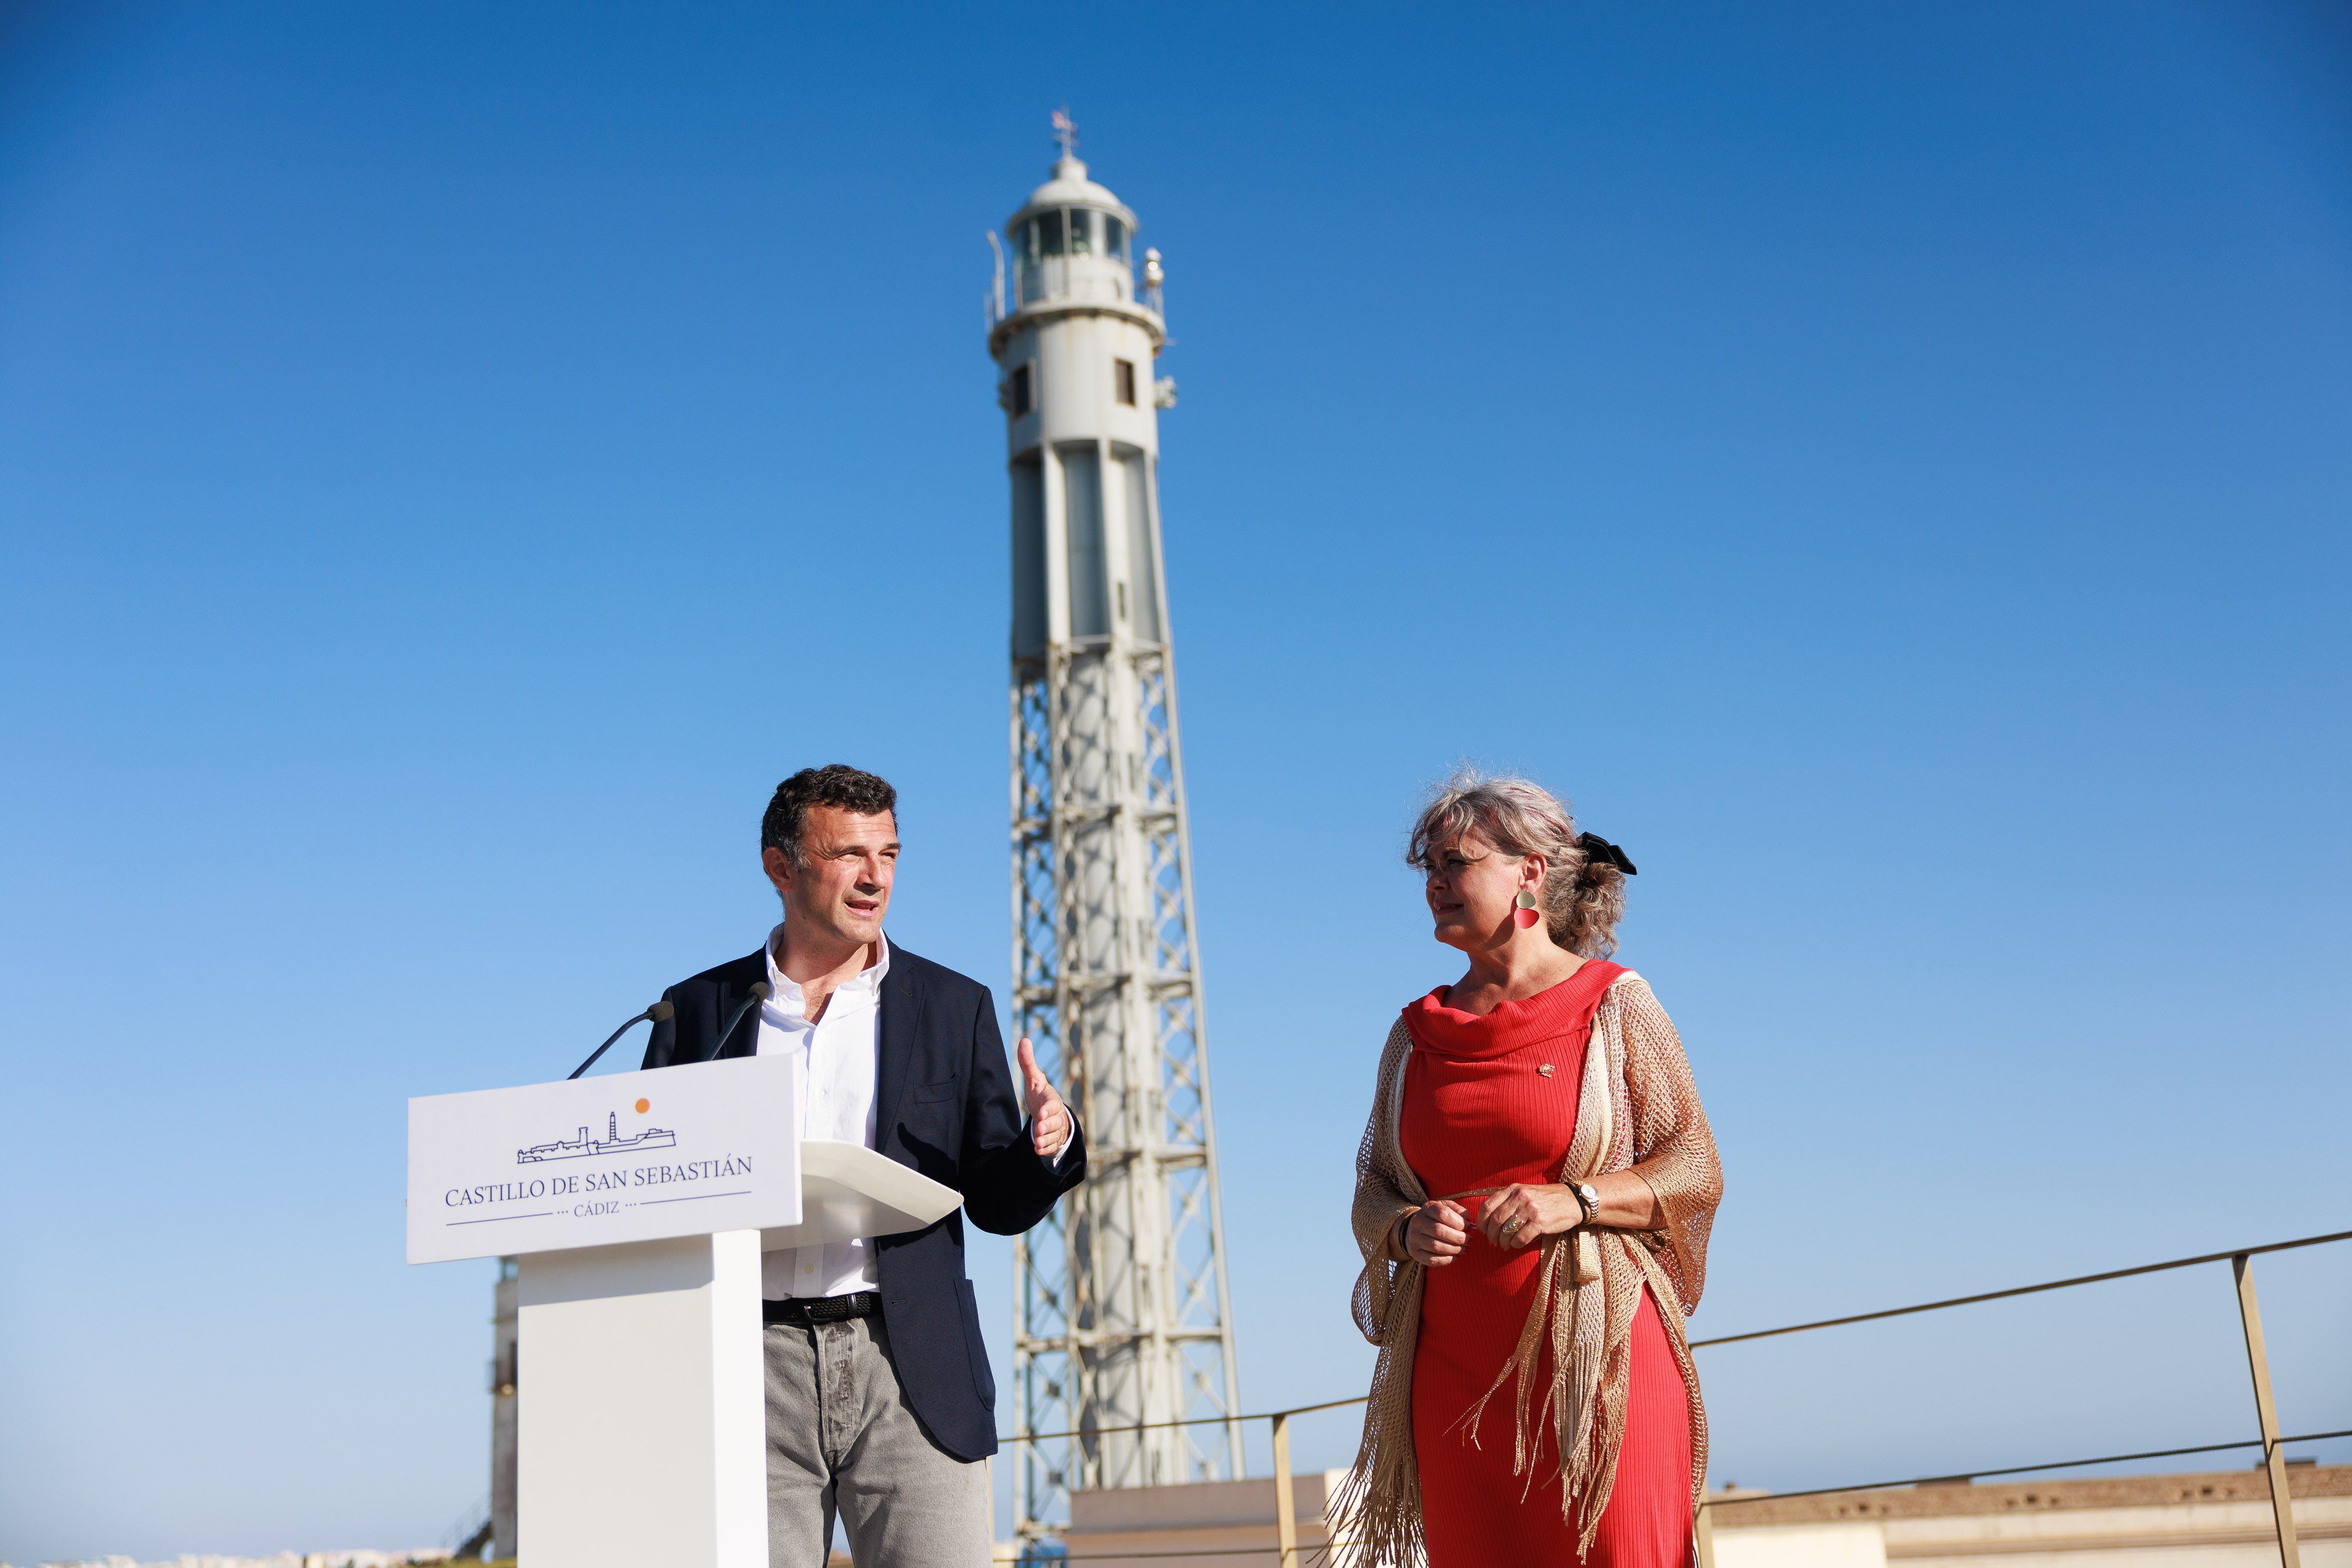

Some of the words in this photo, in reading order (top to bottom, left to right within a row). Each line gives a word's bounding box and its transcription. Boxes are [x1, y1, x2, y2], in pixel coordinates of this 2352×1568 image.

[445, 1179, 545, 1207] CASTILLO
[552, 1175, 579, 1195] DE
[586, 1170, 627, 1192] SAN
[634, 1153, 752, 1186] SEBASTIÁN
[574, 1201, 620, 1217] CÁDIZ
